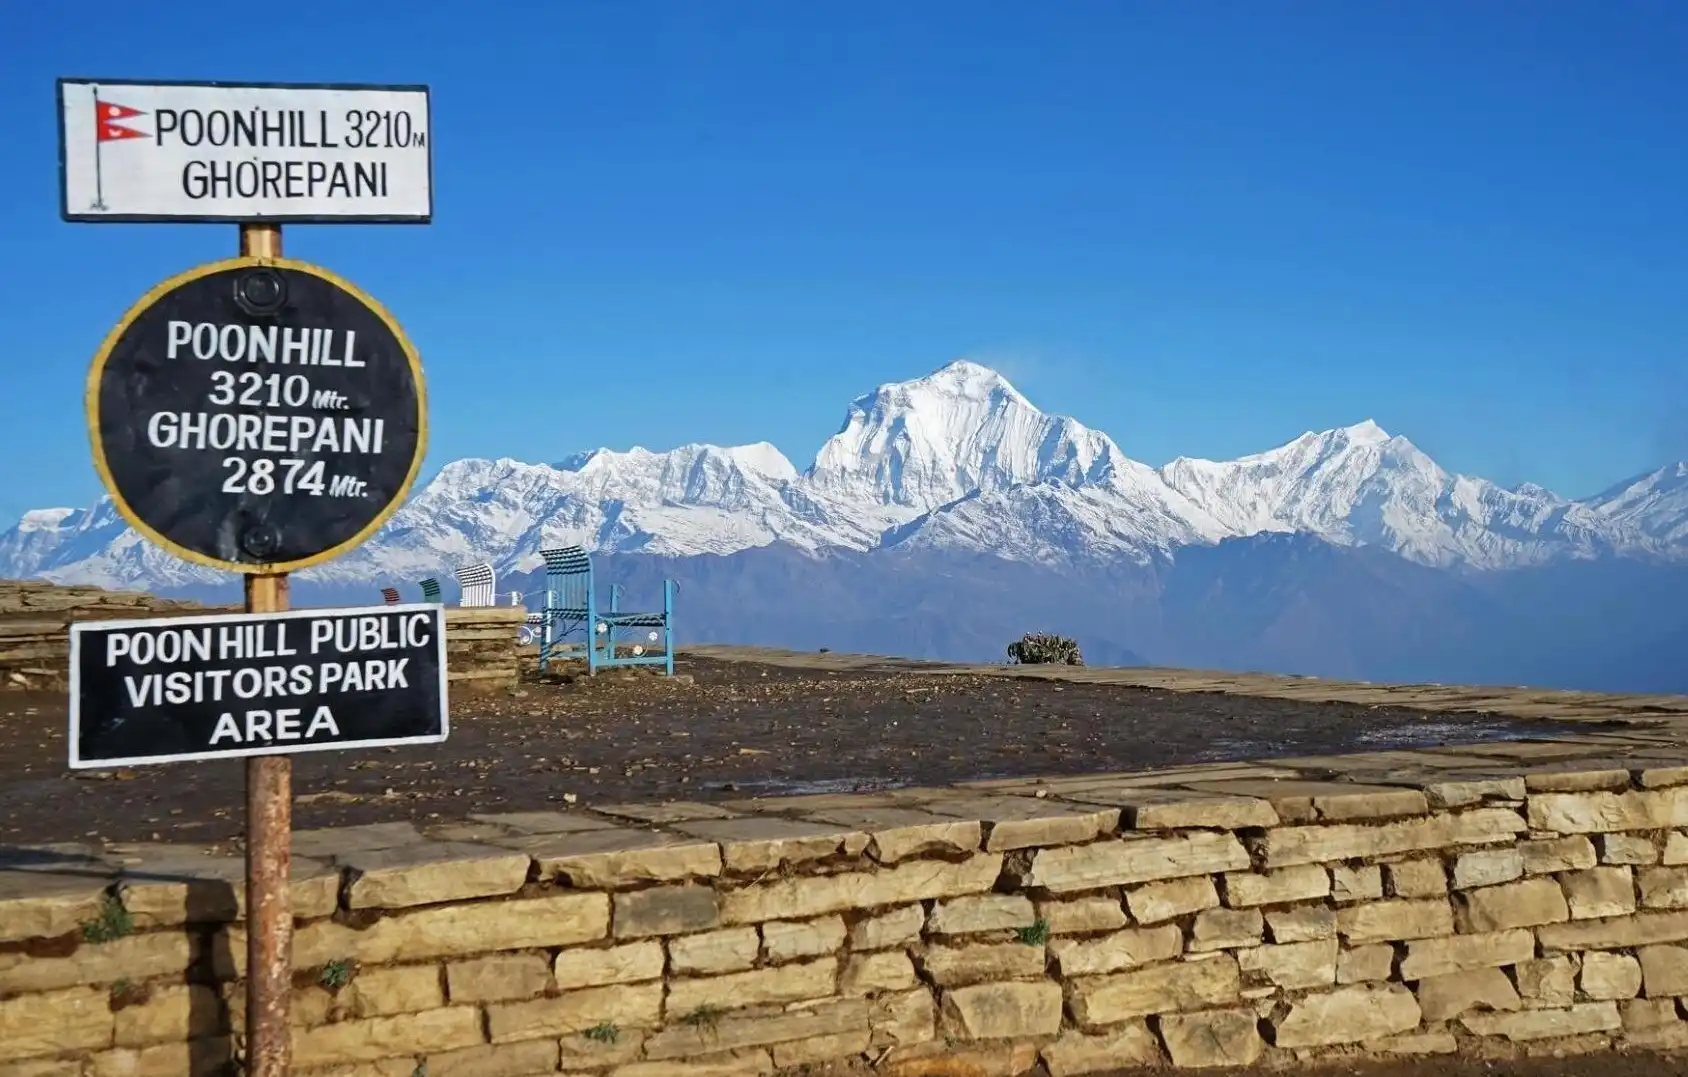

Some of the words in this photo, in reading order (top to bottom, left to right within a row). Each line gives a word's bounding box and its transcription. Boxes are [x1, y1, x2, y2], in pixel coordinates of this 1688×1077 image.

[155, 109, 338, 148] POONHILL
[182, 160, 388, 199] GHOREPANI
[148, 411, 384, 454] GHOREPANI
[221, 456, 325, 496] 2874
[310, 613, 431, 654] PUBLIC
[124, 664, 313, 708] VISITORS
[319, 658, 410, 694] PARK
[208, 705, 340, 745] AREA
